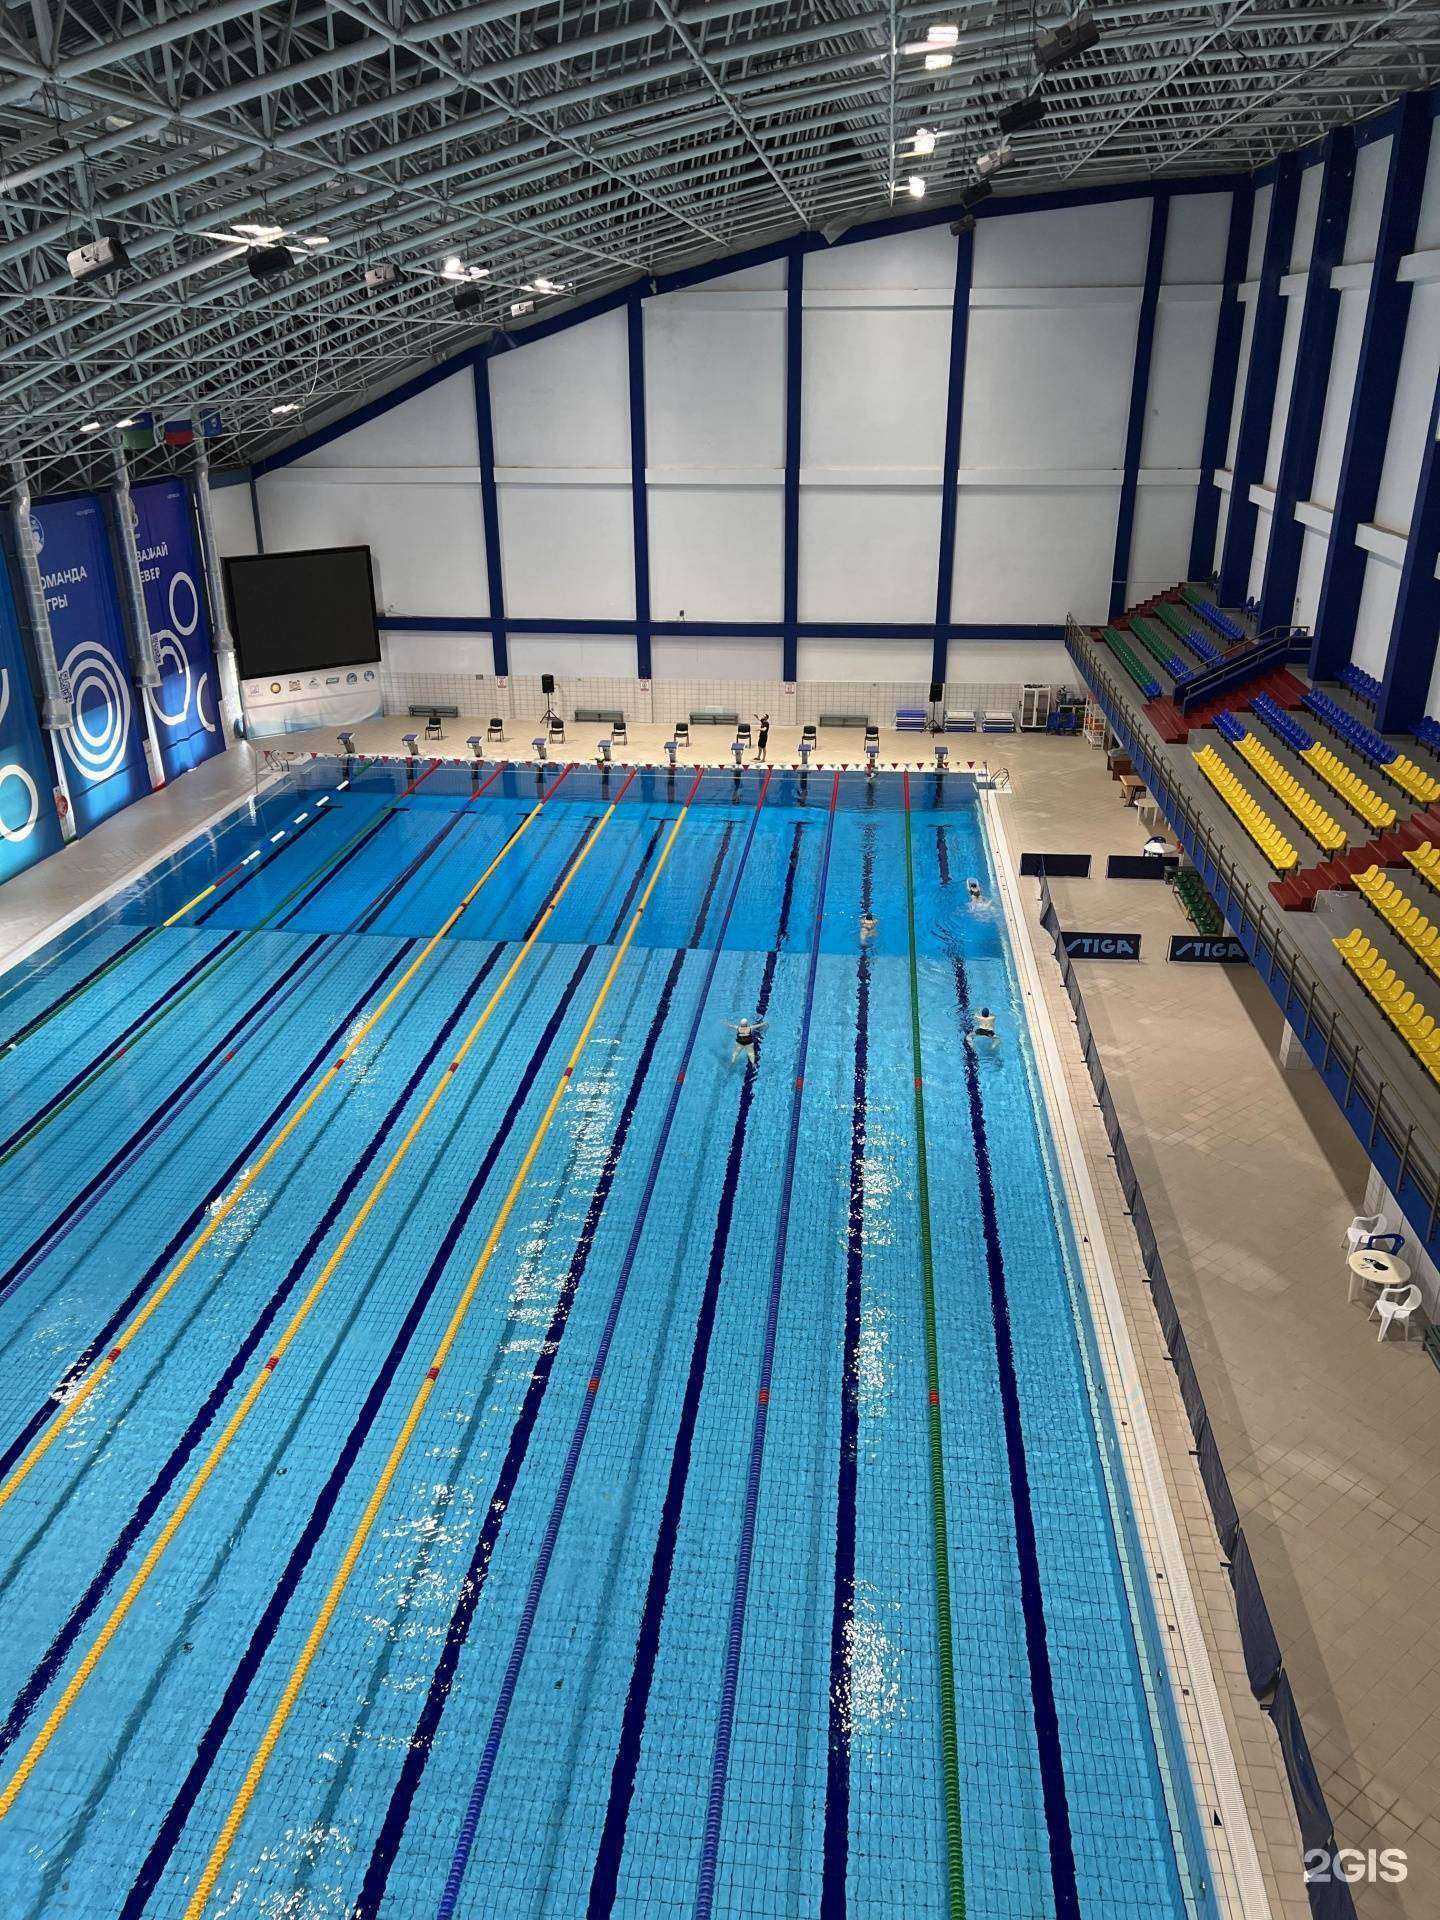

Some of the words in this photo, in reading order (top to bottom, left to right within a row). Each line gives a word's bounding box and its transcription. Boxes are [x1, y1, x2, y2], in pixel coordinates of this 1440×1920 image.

[136, 541, 168, 562] ВАЖАЙ
[40, 565, 88, 590] ОМАНДА
[140, 567, 160, 583] ЕВЕР
[45, 594, 68, 612] ГРЫ
[1066, 938, 1134, 955] STIGA
[1175, 942, 1244, 958] STIGA
